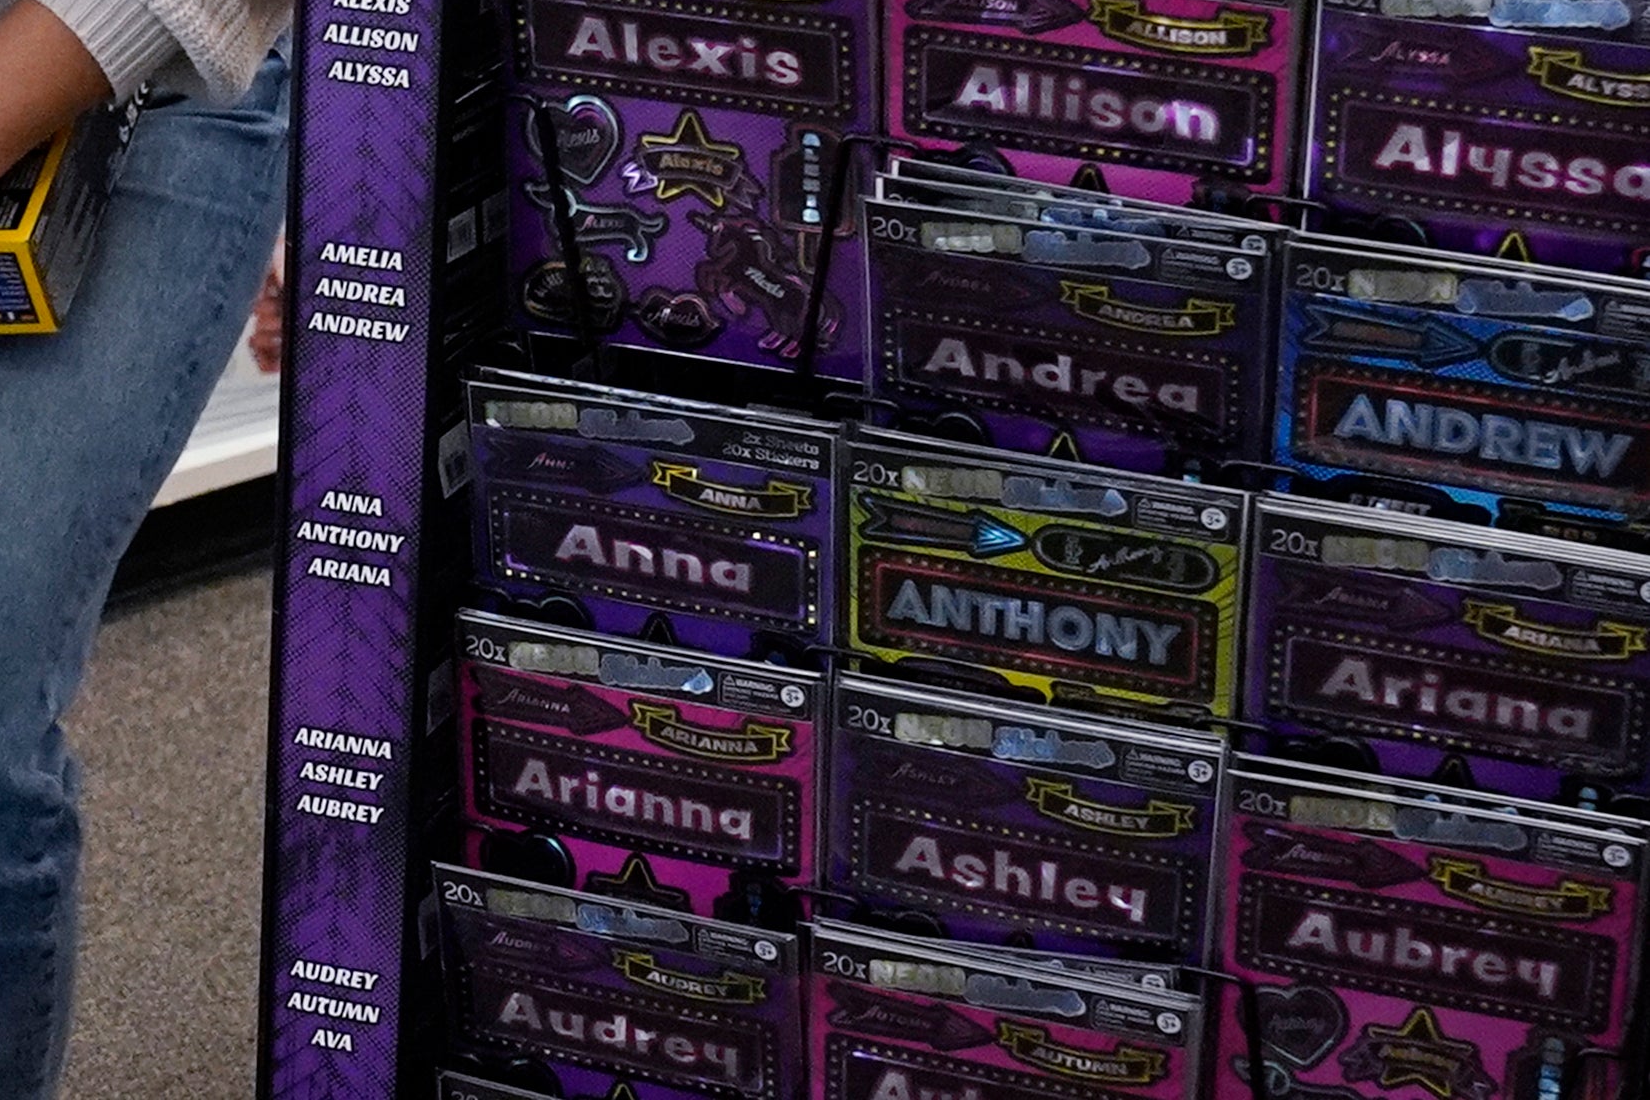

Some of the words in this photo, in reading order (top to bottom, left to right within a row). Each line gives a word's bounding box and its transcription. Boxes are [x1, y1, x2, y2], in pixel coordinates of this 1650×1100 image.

[322, 23, 419, 52] ALLISON
[1125, 19, 1228, 45] ALLISON
[566, 15, 805, 87] Alexis
[328, 60, 410, 88] ALYSSA
[954, 64, 1222, 144] Allison
[658, 152, 725, 177] Alexis
[871, 215, 918, 244] 20x
[320, 242, 403, 271] AMELIA
[314, 277, 406, 307] ANDREA
[1296, 263, 1346, 293] 20x
[308, 312, 410, 343] ANDREW
[1098, 304, 1196, 329] ANDREA
[923, 336, 1200, 414] Andrea
[742, 431, 762, 446] 2x
[1333, 393, 1636, 480] ANDREW
[721, 443, 753, 458] 20x
[754, 447, 821, 470] Stickers
[852, 460, 899, 488] 20x
[320, 490, 383, 517] ANNA
[698, 487, 762, 512] ANNA
[297, 521, 406, 554] ANTHONY
[1270, 528, 1321, 558] 20x
[307, 557, 392, 587] ARIANA
[554, 522, 752, 593] Anna
[886, 577, 1182, 667] ANTHONY
[464, 634, 506, 664] 20x
[1502, 625, 1602, 653] ARIANA
[1319, 655, 1595, 740] Ariana
[849, 705, 892, 736] 20x
[293, 726, 393, 760] ARIANNA
[660, 724, 760, 754] ARIANNA
[299, 761, 384, 791] ASHLEY
[296, 794, 385, 824] AUBREY
[513, 757, 755, 841] Arianna
[1237, 789, 1290, 819] 20x
[1064, 803, 1151, 832] ASHLEY
[441, 880, 484, 908] 20x
[894, 835, 1149, 924] Ashley
[821, 951, 867, 980] 20x
[1286, 909, 1561, 999] Aubrey
[290, 960, 379, 990] AUDREY
[646, 969, 730, 998] AUDREY
[287, 992, 381, 1023] AUTUMN
[311, 1029, 353, 1051] AVA
[497, 991, 741, 1079] Audrey
[1031, 1046, 1130, 1076] AUTUMN
